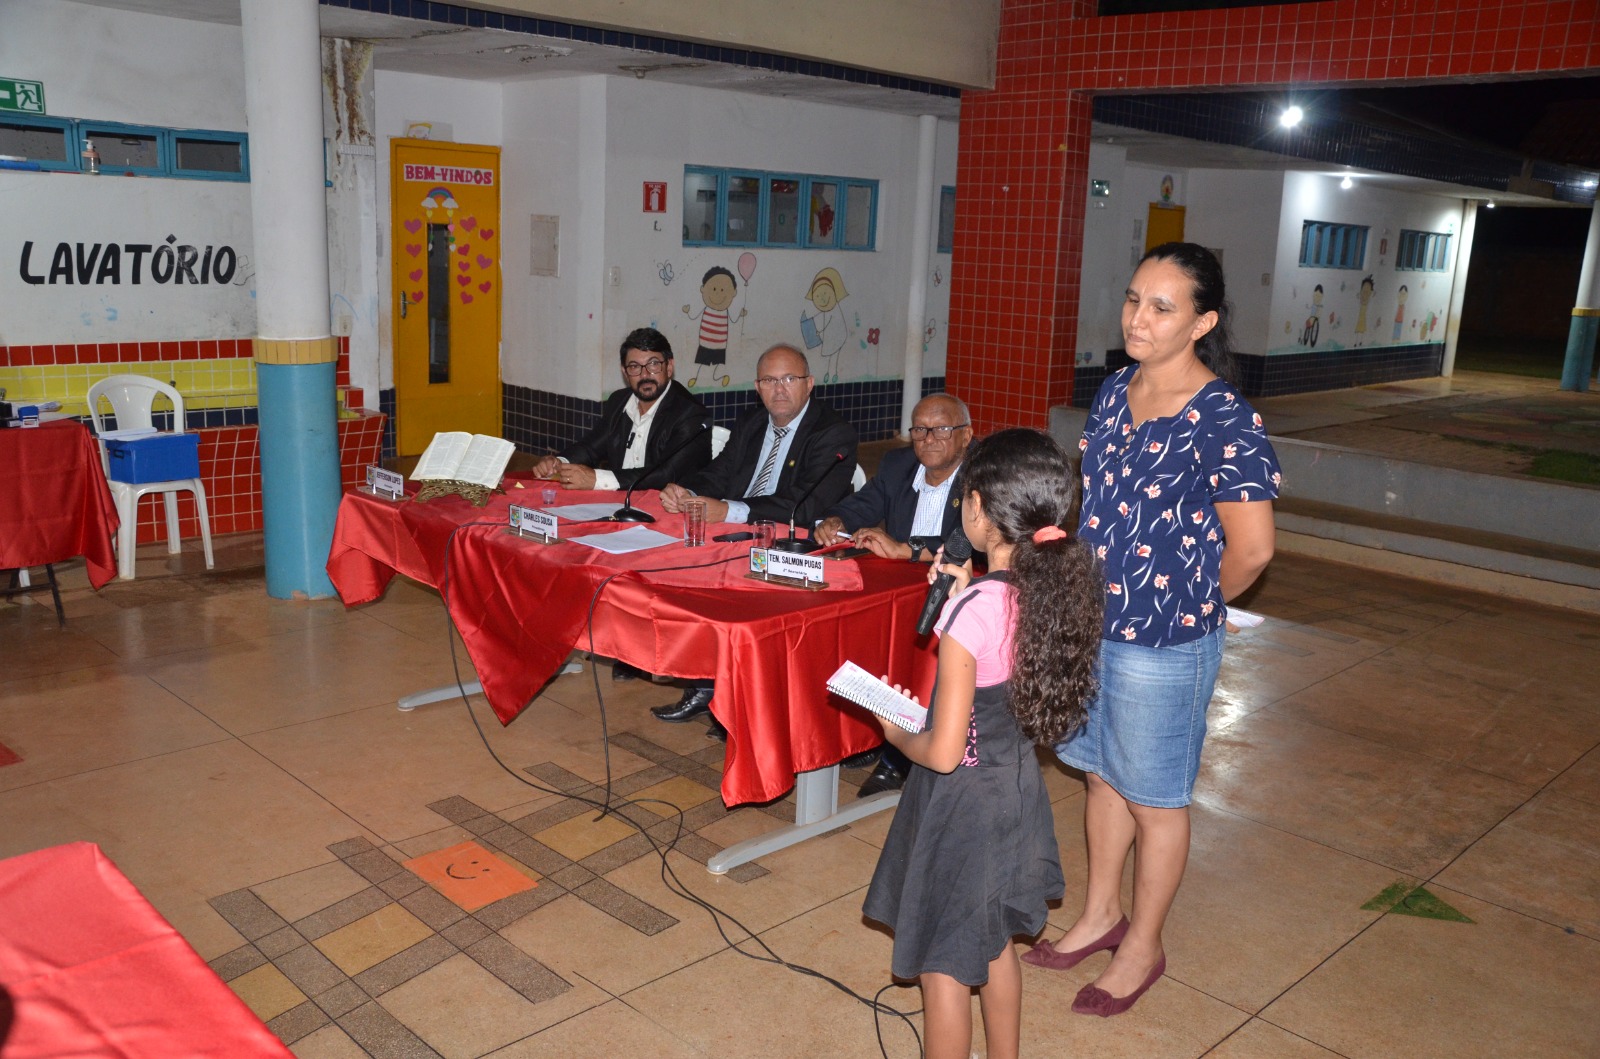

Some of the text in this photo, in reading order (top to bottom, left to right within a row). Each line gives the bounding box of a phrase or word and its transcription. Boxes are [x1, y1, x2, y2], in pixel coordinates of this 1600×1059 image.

[405, 165, 492, 184] BEM-VINDOS
[20, 234, 236, 285] LAVATÓRIO
[523, 511, 553, 526] CHARLES SOUSA
[769, 553, 822, 570] TEN. SALMON PUGAS
